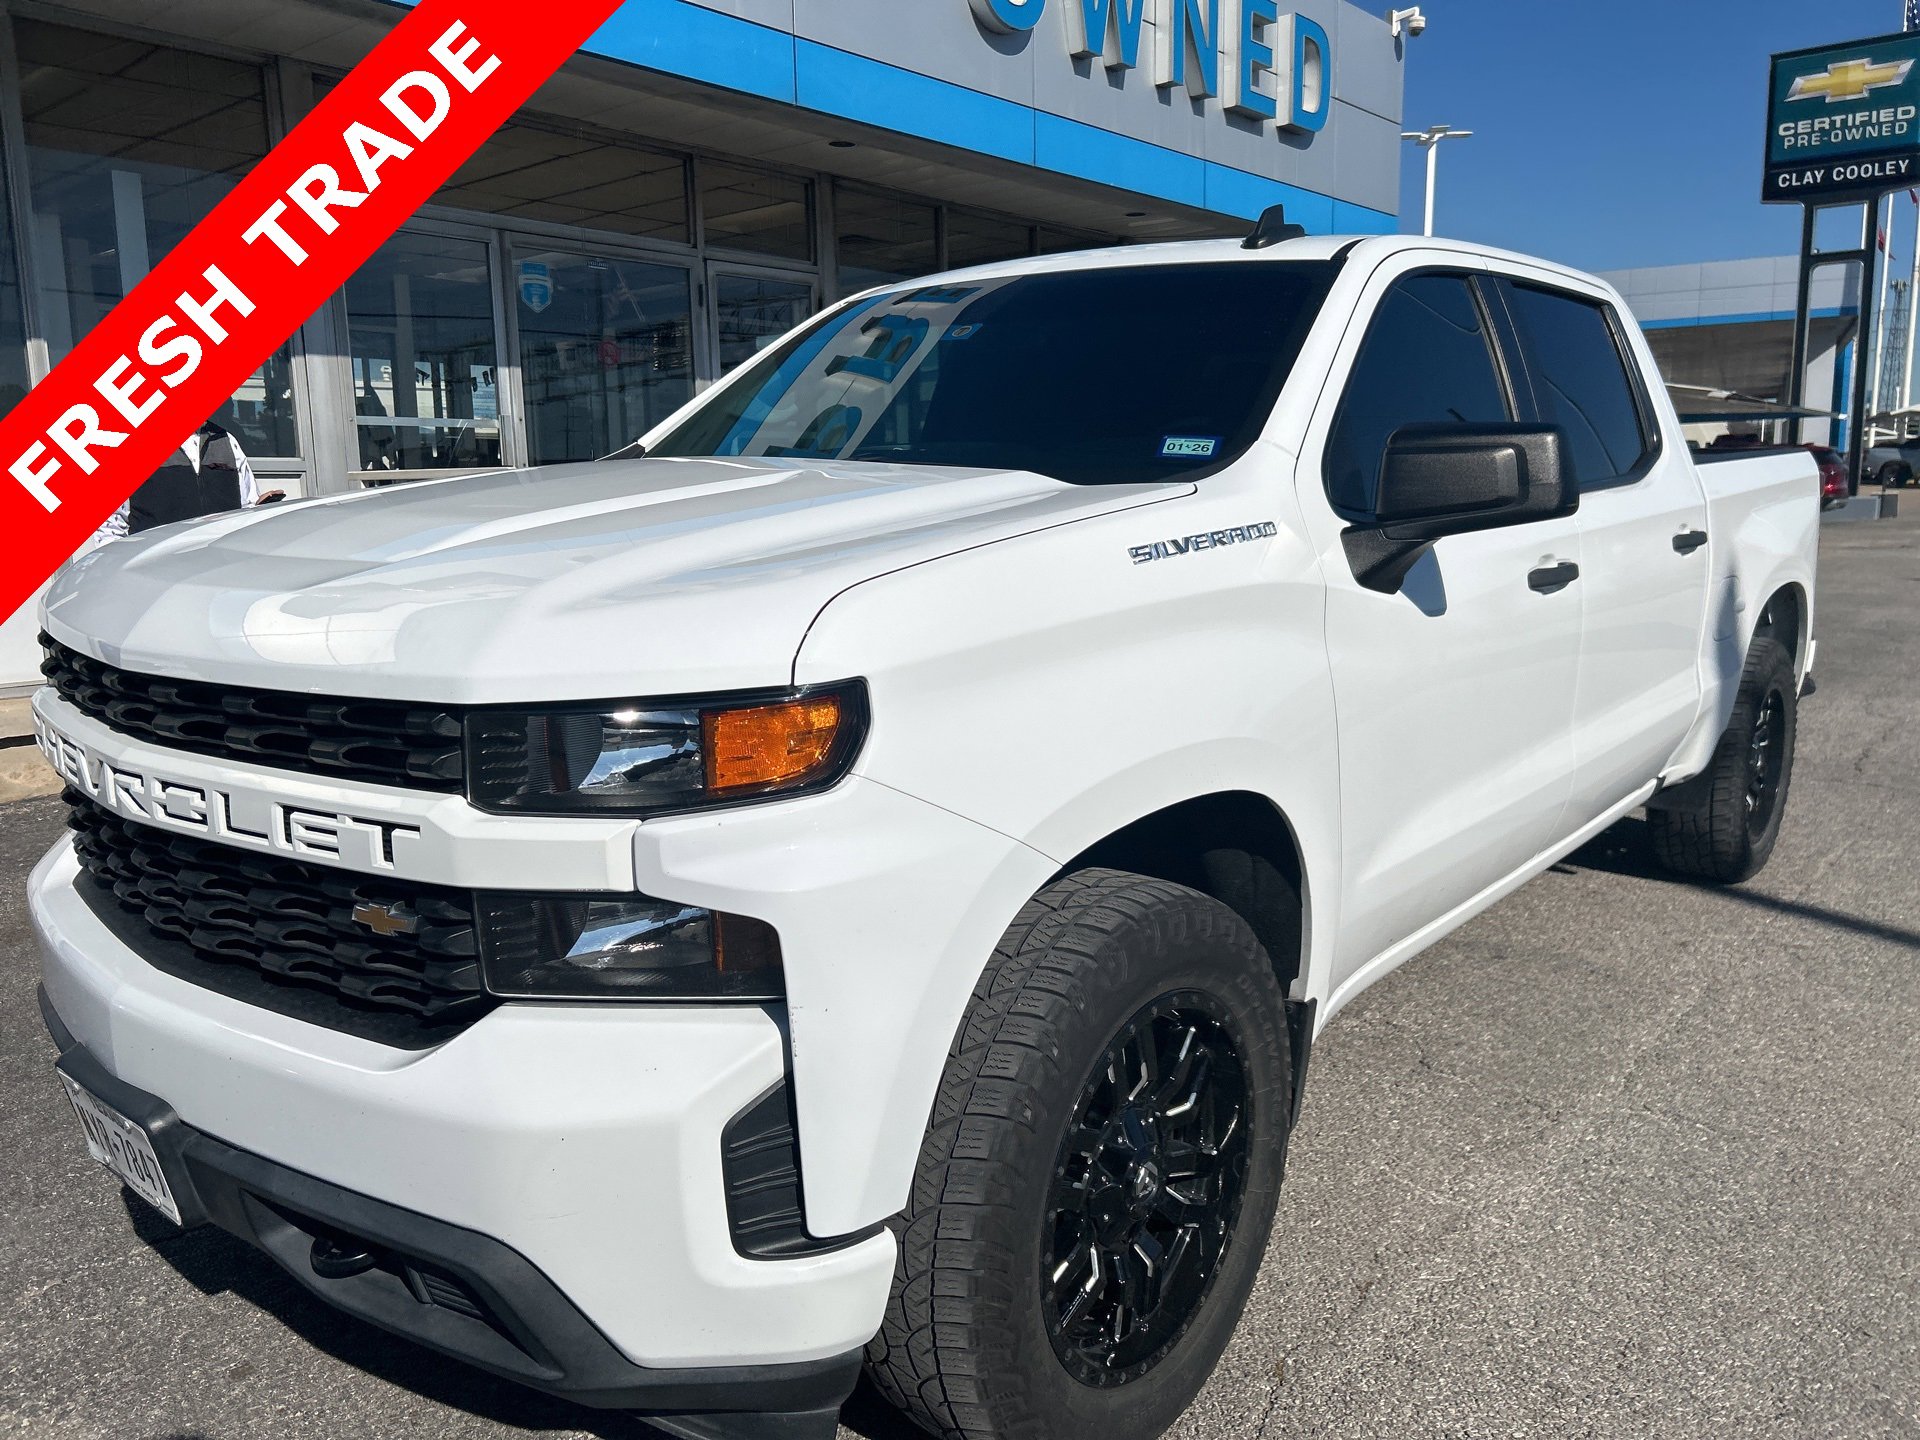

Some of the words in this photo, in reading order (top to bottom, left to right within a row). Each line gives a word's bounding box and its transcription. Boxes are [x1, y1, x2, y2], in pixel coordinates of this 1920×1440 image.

[968, 0, 1331, 133] WNED
[1778, 105, 1916, 136] CERTIFIED
[1783, 121, 1908, 149] PRE-OWNED
[1778, 169, 1825, 188] CLAY
[1832, 159, 1910, 182] COOLEY
[1166, 442, 1184, 451] 01
[1191, 443, 1211, 453] 26
[1127, 521, 1278, 565] SILVERADO
[32, 708, 421, 870] CHEVROLET
